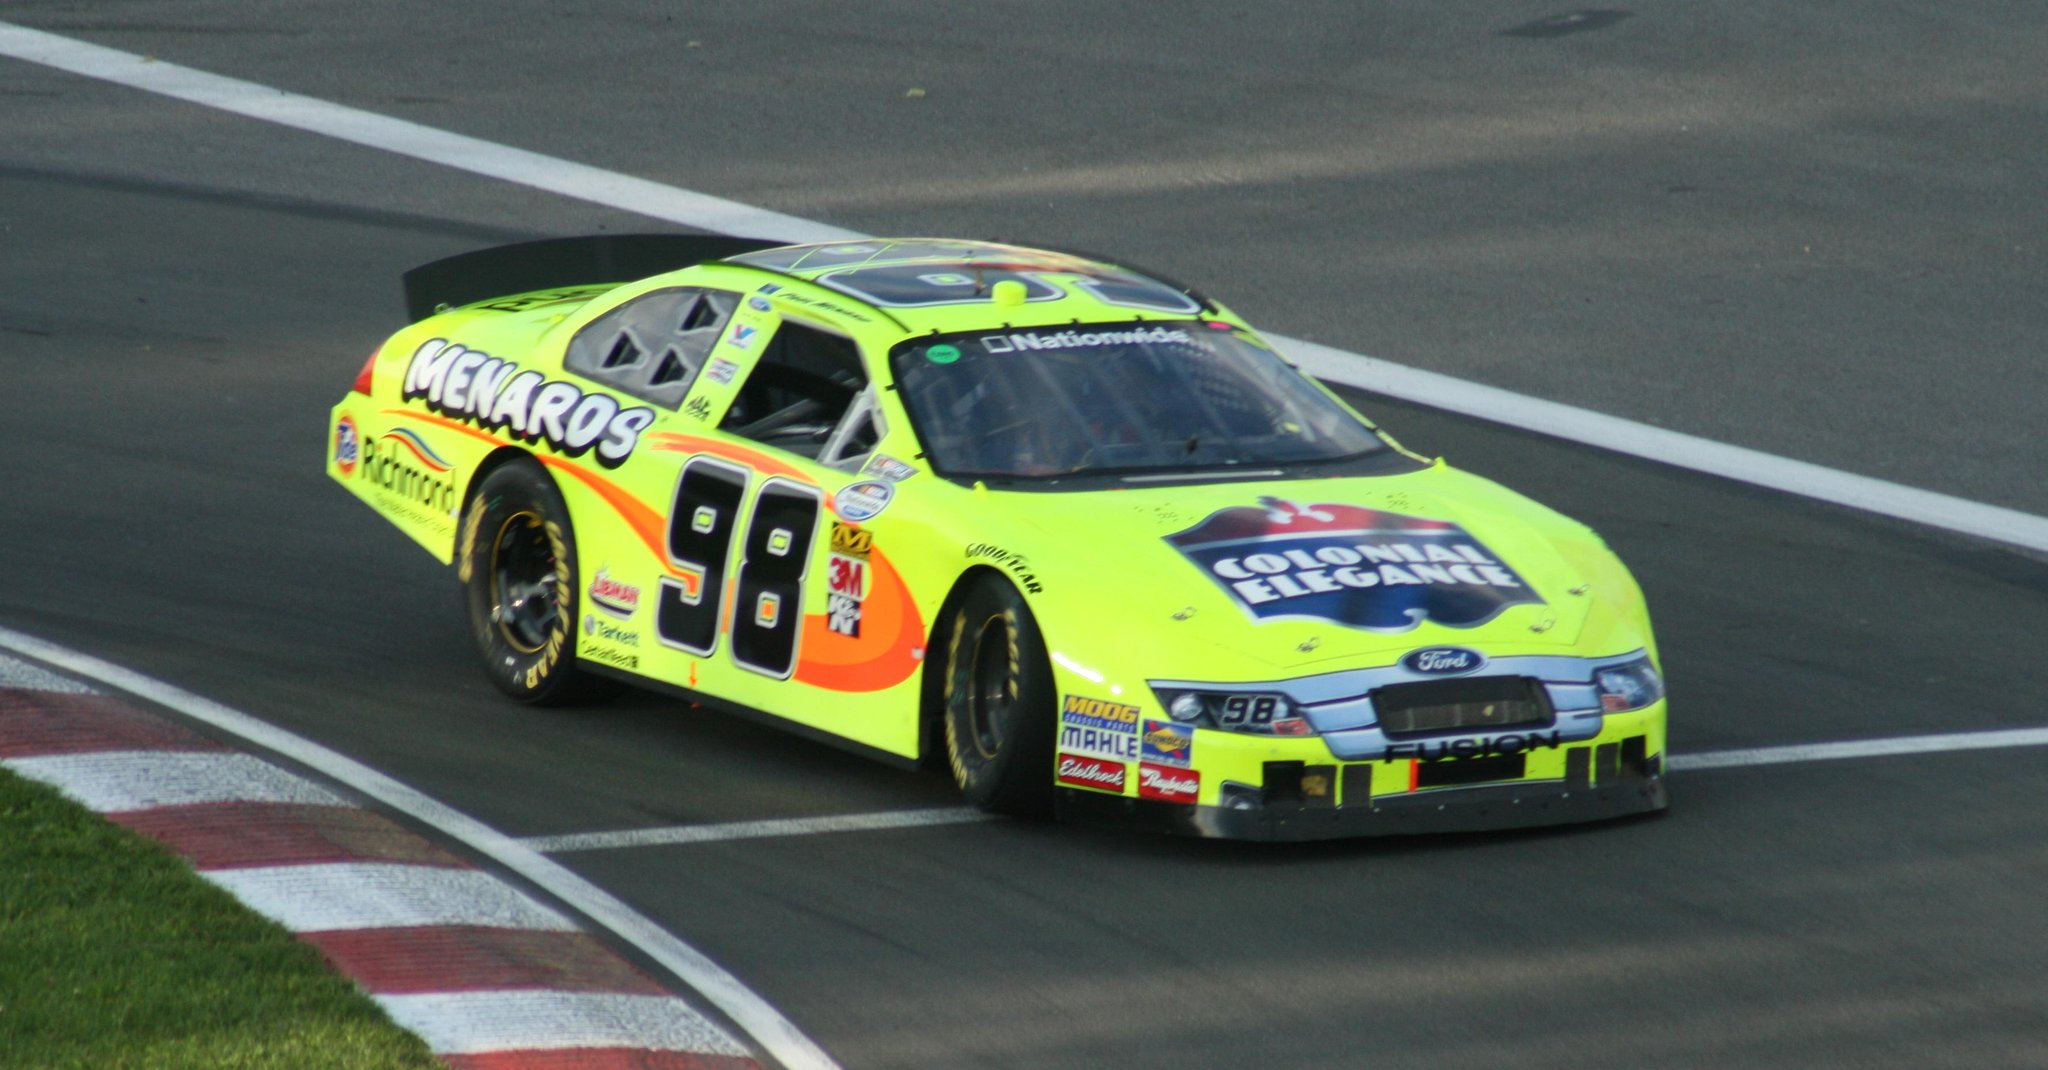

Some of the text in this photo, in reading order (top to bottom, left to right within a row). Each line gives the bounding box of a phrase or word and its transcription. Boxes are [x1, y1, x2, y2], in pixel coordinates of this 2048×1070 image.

[1008, 327, 1190, 351] Nationwide
[361, 436, 458, 516] Richmond
[655, 455, 824, 681] 98
[829, 556, 863, 598] 3M
[964, 542, 1043, 594] GOODYEAR
[1213, 543, 1499, 579] COLONIAL
[1230, 563, 1521, 605] ELEGANCE
[1417, 649, 1470, 672] Ford
[1064, 696, 1139, 724] MOOG
[1221, 695, 1279, 725] 98
[1061, 725, 1138, 758] MAHLE
[1383, 730, 1561, 764] FUSION
[1059, 758, 1124, 786] Edelbrock
